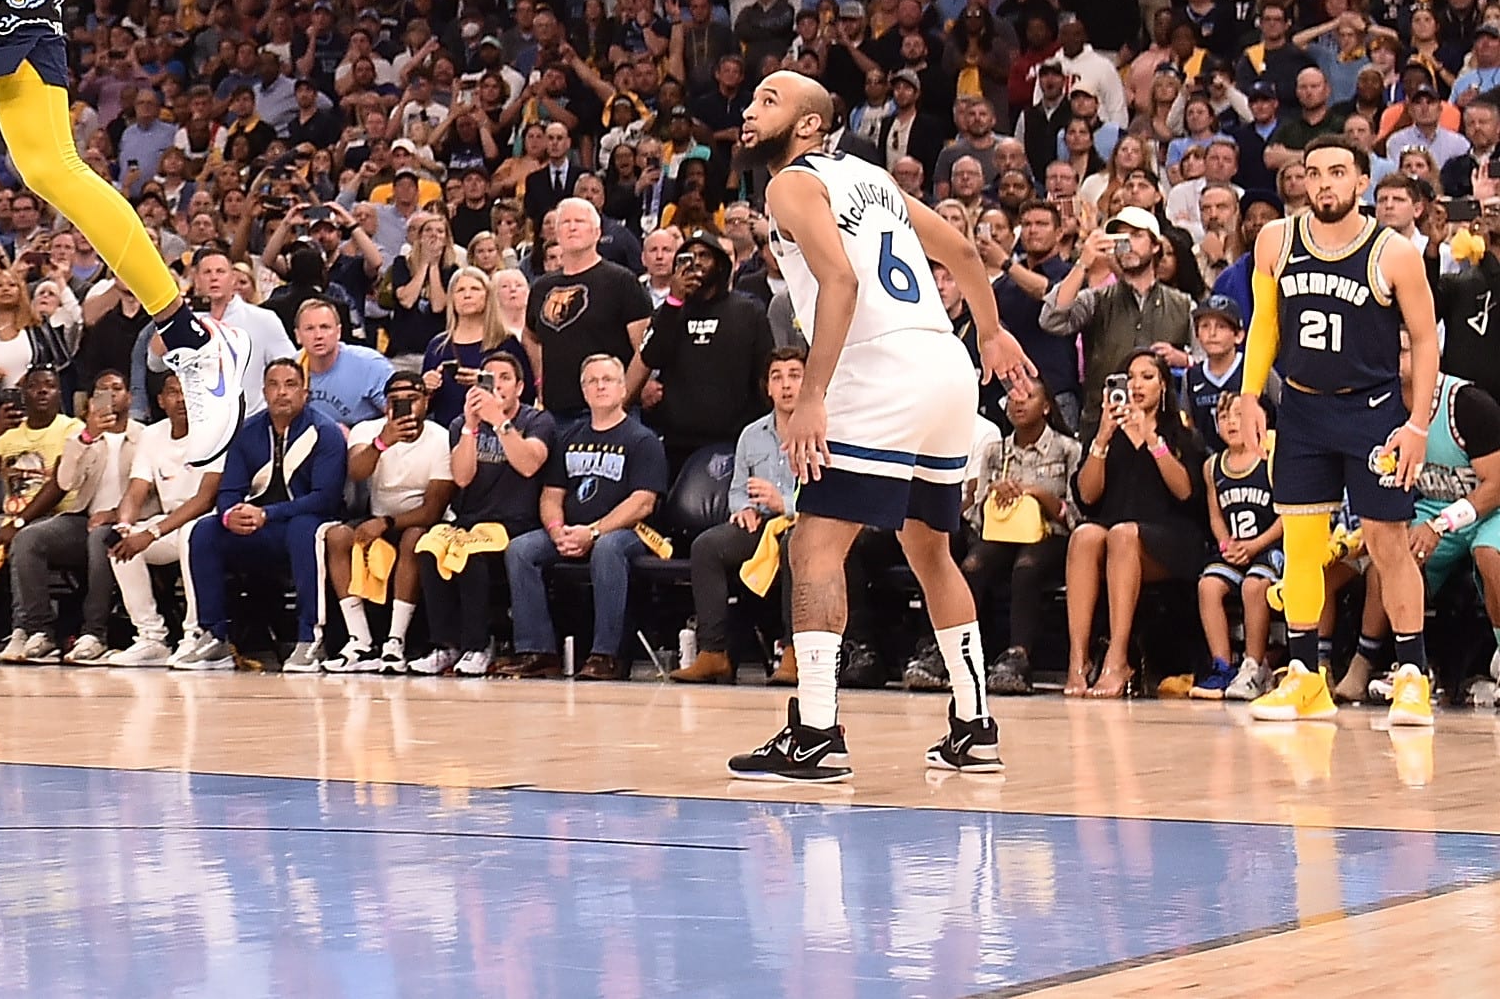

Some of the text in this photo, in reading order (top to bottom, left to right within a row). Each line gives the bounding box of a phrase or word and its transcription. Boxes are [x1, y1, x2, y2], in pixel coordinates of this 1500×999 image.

[878, 231, 920, 304] 6
[1280, 272, 1370, 306] MEMPHIS
[1299, 309, 1342, 352] 21
[1219, 487, 1270, 510] MEMPHIS
[1230, 510, 1258, 539] 12
